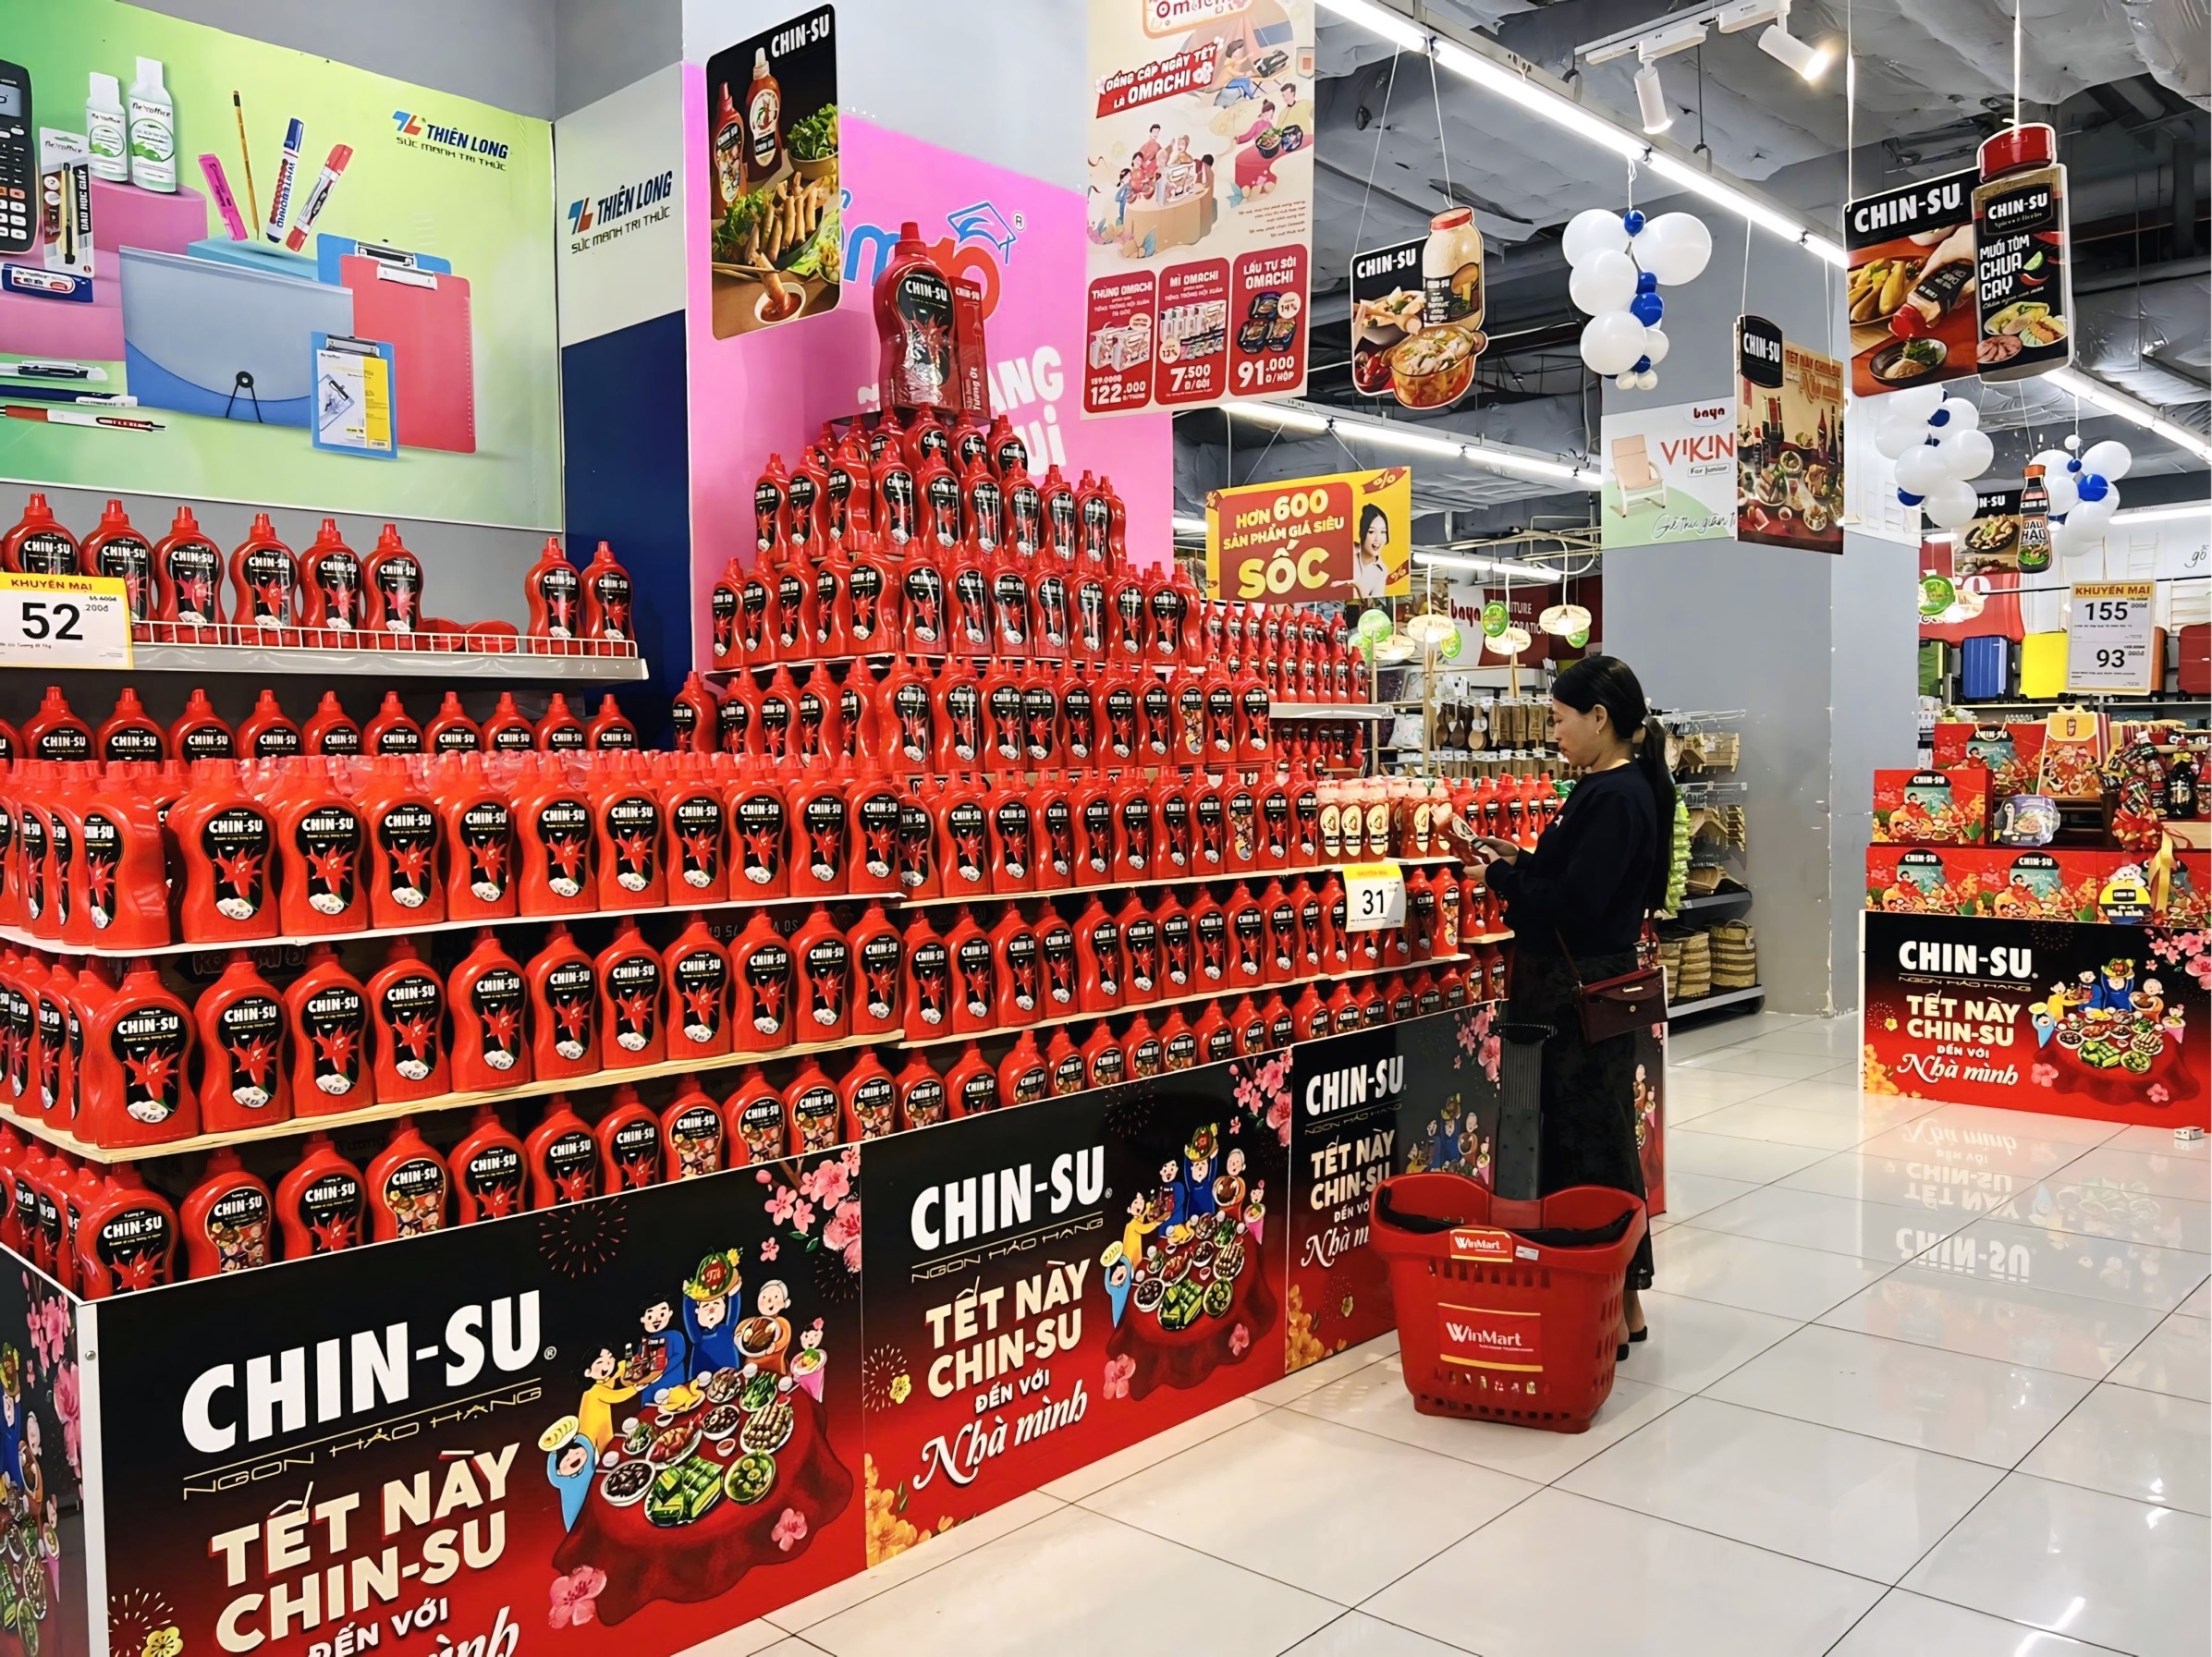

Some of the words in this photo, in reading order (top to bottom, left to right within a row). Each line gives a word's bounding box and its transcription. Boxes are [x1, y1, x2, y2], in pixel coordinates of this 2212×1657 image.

[771, 13, 830, 58] CHIN-SU
[1161, 52, 1190, 74] NGÀY
[1194, 42, 1216, 63] TẾT
[1113, 95, 1126, 109] LÀ
[1128, 70, 1191, 104] OMACHI
[426, 123, 467, 148] THIÊN
[471, 136, 508, 159] LONG
[397, 137, 418, 148] SỨC
[459, 152, 475, 163] TRI
[479, 156, 507, 171] THỨC
[597, 185, 633, 225] THIÊN
[637, 170, 673, 209] LONG
[1854, 183, 1961, 232] CHIN-SU
[1988, 192, 2048, 220] CHIN-SU
[571, 237, 590, 254] SỨC
[625, 220, 641, 235] TRI
[643, 206, 671, 226] THỨC
[2008, 235, 2030, 252] TÔM
[1281, 255, 1296, 268] SÔI
[1357, 248, 1416, 279] CHIN-SU
[1980, 252, 2023, 281] CHUA
[906, 280, 948, 301] CHIN-SU
[1120, 281, 1154, 295] OMACHI
[1170, 274, 1181, 286] MÌ
[1183, 271, 1218, 285] OMACHI
[1246, 270, 1293, 290] OMACHI
[1982, 275, 2012, 301] CAY
[955, 286, 980, 300] CHIN-SU
[1743, 332, 1780, 362] CHIN-SU
[1660, 432, 1734, 466] VIKIN
[1690, 466, 1703, 475] For
[1705, 465, 1728, 475] Junior
[1236, 508, 1270, 529] HƠN
[1273, 488, 1329, 521] 600
[1979, 495, 2006, 508] N-SU
[1223, 533, 1248, 551] SẢN
[1250, 523, 1287, 545] PHẨM
[1289, 519, 1312, 538] GIÁ
[1313, 516, 1345, 533] SIÊU
[102, 545, 146, 558] CHIN-SU
[248, 556, 289, 567] CHIN-SU
[380, 565, 416, 577] CHIN-SU
[1237, 540, 1331, 599] SỐC
[69, 582, 92, 593] MẠI
[599, 579, 628, 589] CHIN-SU
[2128, 586, 2150, 597] MẠI
[22, 603, 83, 640] 52
[1450, 599, 1481, 627] baya
[2085, 603, 2128, 621] 155
[2096, 649, 2124, 667] 93
[188, 735, 227, 745] CHIN-SU
[439, 734, 474, 743] CHIN-SU
[1913, 775, 1945, 786] CHIN-SU
[385, 813, 431, 827] CHIN-SU
[542, 809, 585, 822] CHIN-SU
[740, 804, 778, 815] CHIN-SU
[951, 810, 982, 821] CHIN-SU
[209, 819, 263, 834] CHIN-SU
[1905, 854, 1936, 863] CHIN-SU
[2019, 857, 2052, 867] CHIN-SU
[1363, 889, 1383, 915] 31
[961, 946, 989, 956] CHIN-SU
[1899, 941, 2032, 979] CHIN-SU
[679, 959, 721, 972] CHIN-SU
[476, 977, 519, 993] CHIN-SU
[1899, 976, 1942, 985] NGON
[224, 1005, 276, 1023] CHIN-SU
[307, 996, 358, 1013] CHIN-SU
[1906, 990, 1958, 1017] TẾT
[1965, 996, 2021, 1024] NÀY
[1906, 1017, 2014, 1047] CHIN-SU
[1937, 1042, 1964, 1057] ĐẾN
[1967, 1045, 1989, 1059] VỚI
[1897, 1054, 1959, 1084] Nhà
[1963, 1063, 2019, 1087] mình
[1306, 1055, 1403, 1116] CHIN-SU
[677, 1114, 715, 1129] CHIN-SU
[470, 1155, 517, 1172] CHIN-SU
[1311, 1135, 1351, 1178] TẾT
[1356, 1127, 1396, 1166] NÀY
[910, 1145, 1105, 1251] CHIN-SU
[1311, 1161, 1390, 1211] CHIN-SU
[214, 1196, 263, 1216] CHIN-SU
[1335, 1205, 1353, 1223] ĐẾN
[1357, 1200, 1370, 1218] VỚ
[911, 1253, 980, 1283] NGON
[989, 1238, 1036, 1261] HẢO
[1043, 1217, 1104, 1242] HẠNG
[1301, 1226, 1350, 1268] Nhà
[1455, 1237, 1501, 1249] WinMart
[925, 1275, 1005, 1349] TẾT
[1016, 1259, 1091, 1322] NÀY
[1446, 1322, 1522, 1346] WinMart
[928, 1308, 1082, 1399] CHIN-SU
[182, 1290, 541, 1453] CHIN-SU
[975, 1383, 1013, 1415] ĐẾN
[1019, 1368, 1050, 1395] VỚI
[184, 1453, 314, 1500] NGON
[329, 1422, 419, 1457] HẢO
[430, 1387, 542, 1429] HẠNG
[913, 1414, 1008, 1490] Nhà
[1013, 1379, 1089, 1446] mình
[209, 1480, 359, 1586] TẾT
[382, 1442, 519, 1539] NÀY
[215, 1509, 507, 1652] CHIN-SU
[307, 1621, 379, 1657] ĐẾN
[390, 1597, 449, 1637] VỚI
